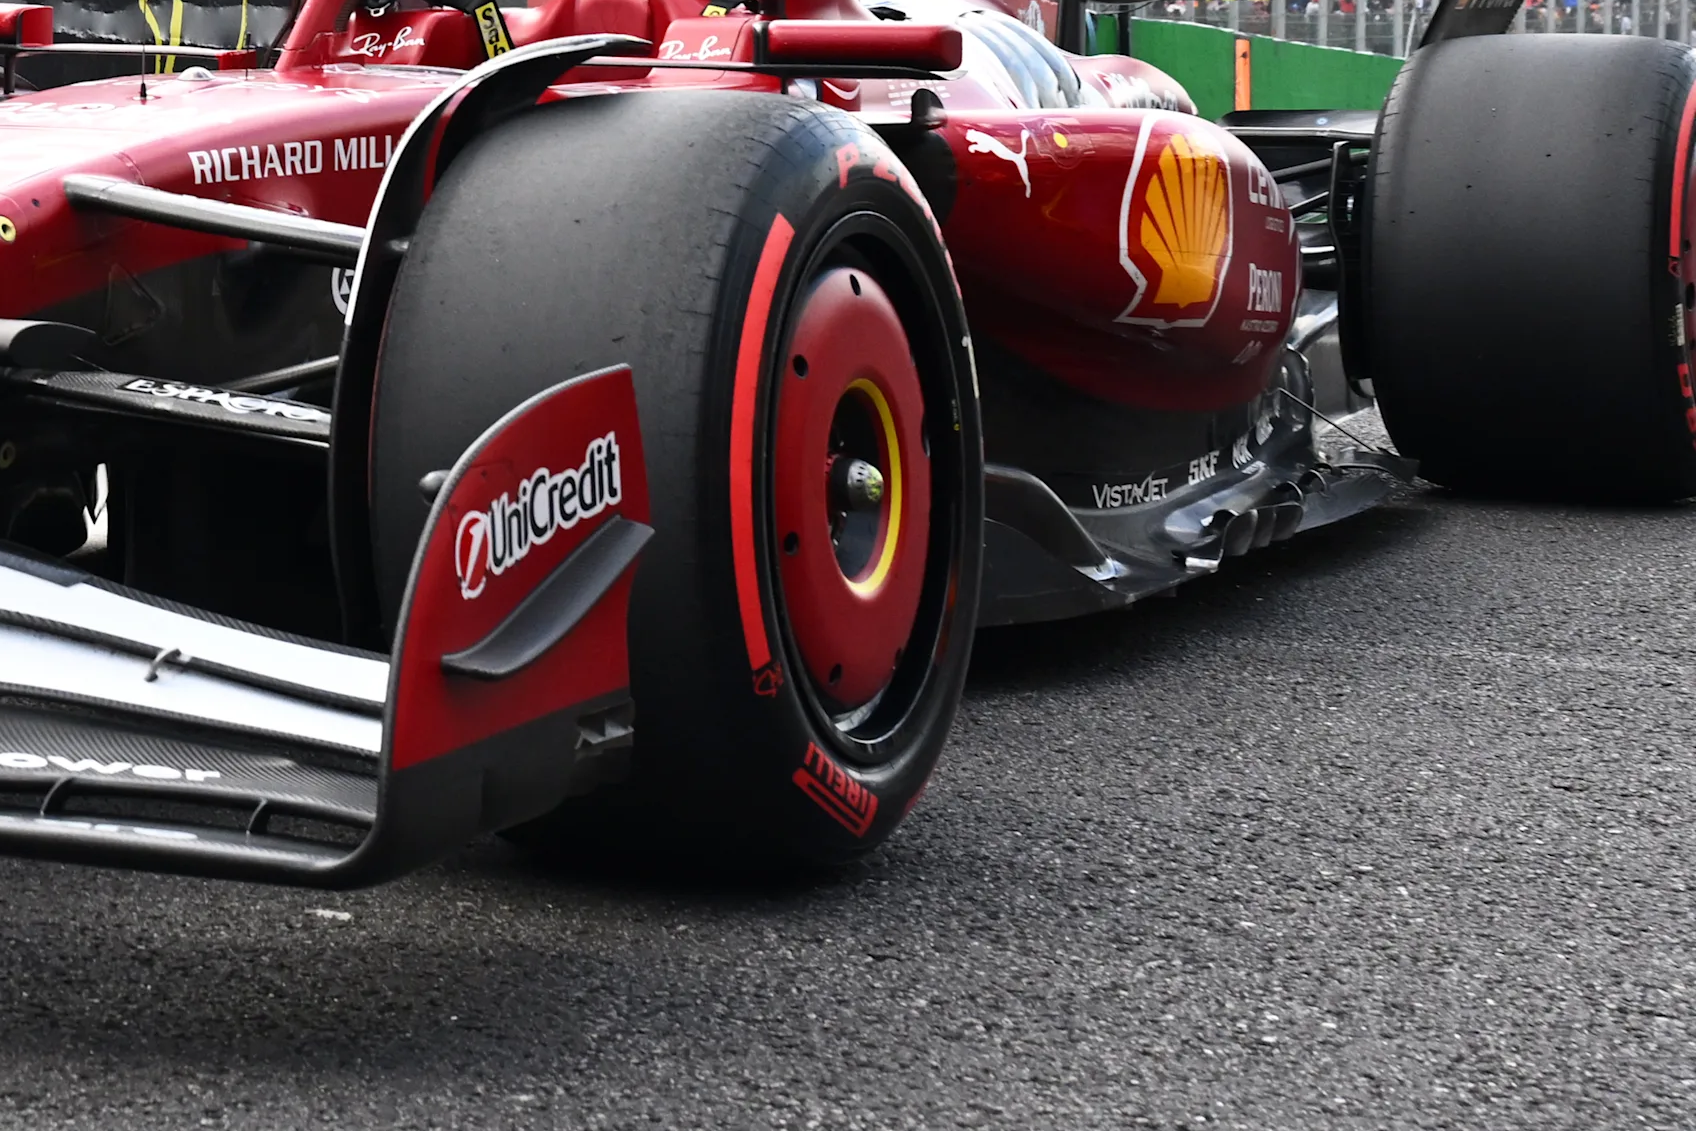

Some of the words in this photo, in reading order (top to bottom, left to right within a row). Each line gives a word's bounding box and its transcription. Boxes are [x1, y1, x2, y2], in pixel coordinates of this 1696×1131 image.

[349, 26, 426, 57] Ray-Ban
[187, 139, 323, 185] RICHARD
[1247, 263, 1282, 312] PERONI
[1188, 450, 1220, 486] SKF
[486, 432, 622, 574] UniCredit
